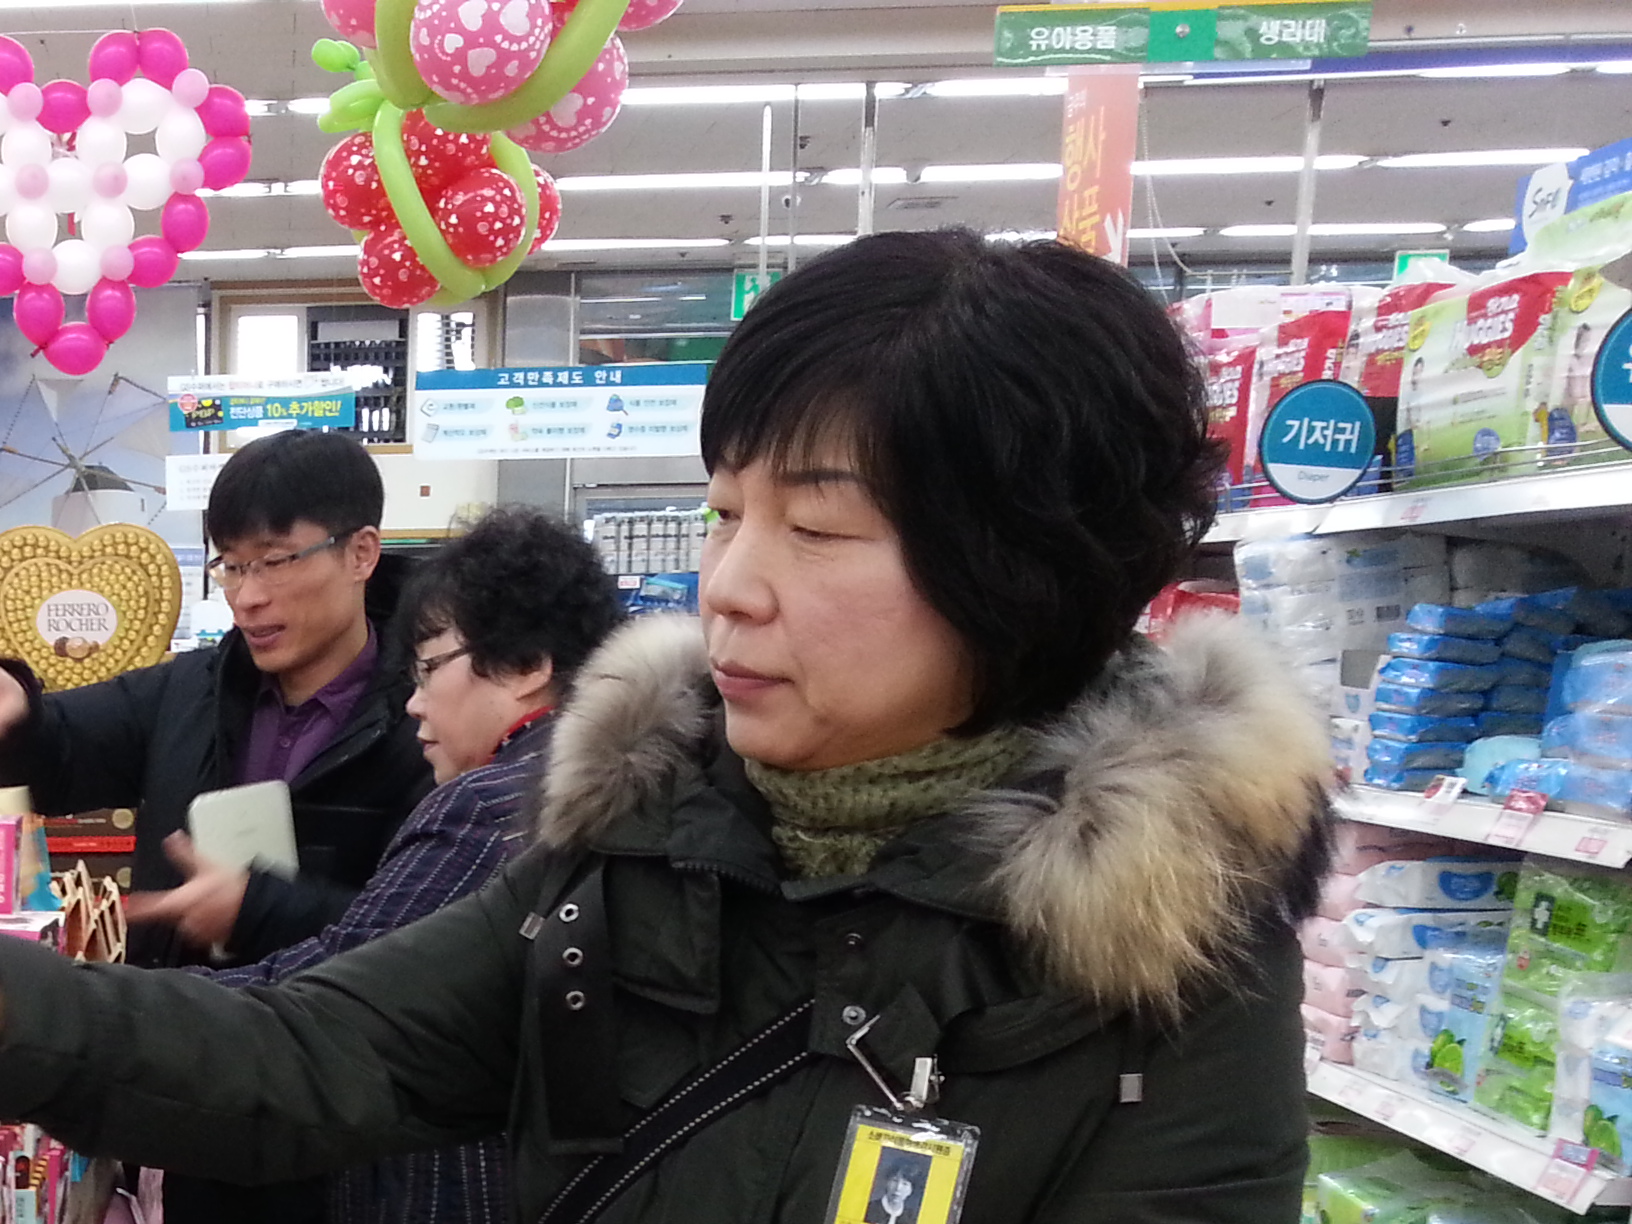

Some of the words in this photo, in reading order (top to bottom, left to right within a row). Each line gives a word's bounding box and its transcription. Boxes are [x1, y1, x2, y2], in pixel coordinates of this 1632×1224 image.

[1028, 25, 1117, 51] 유아용품
[1259, 18, 1326, 45] 생리대
[497, 370, 584, 386] 고객만족제도
[595, 369, 623, 384] 안내
[289, 400, 341, 417] 추가할인!
[1282, 416, 1361, 454] 기저귀
[1297, 471, 1329, 483] Diaper
[47, 602, 109, 617] FERRERO
[47, 617, 109, 632] ROCHER
